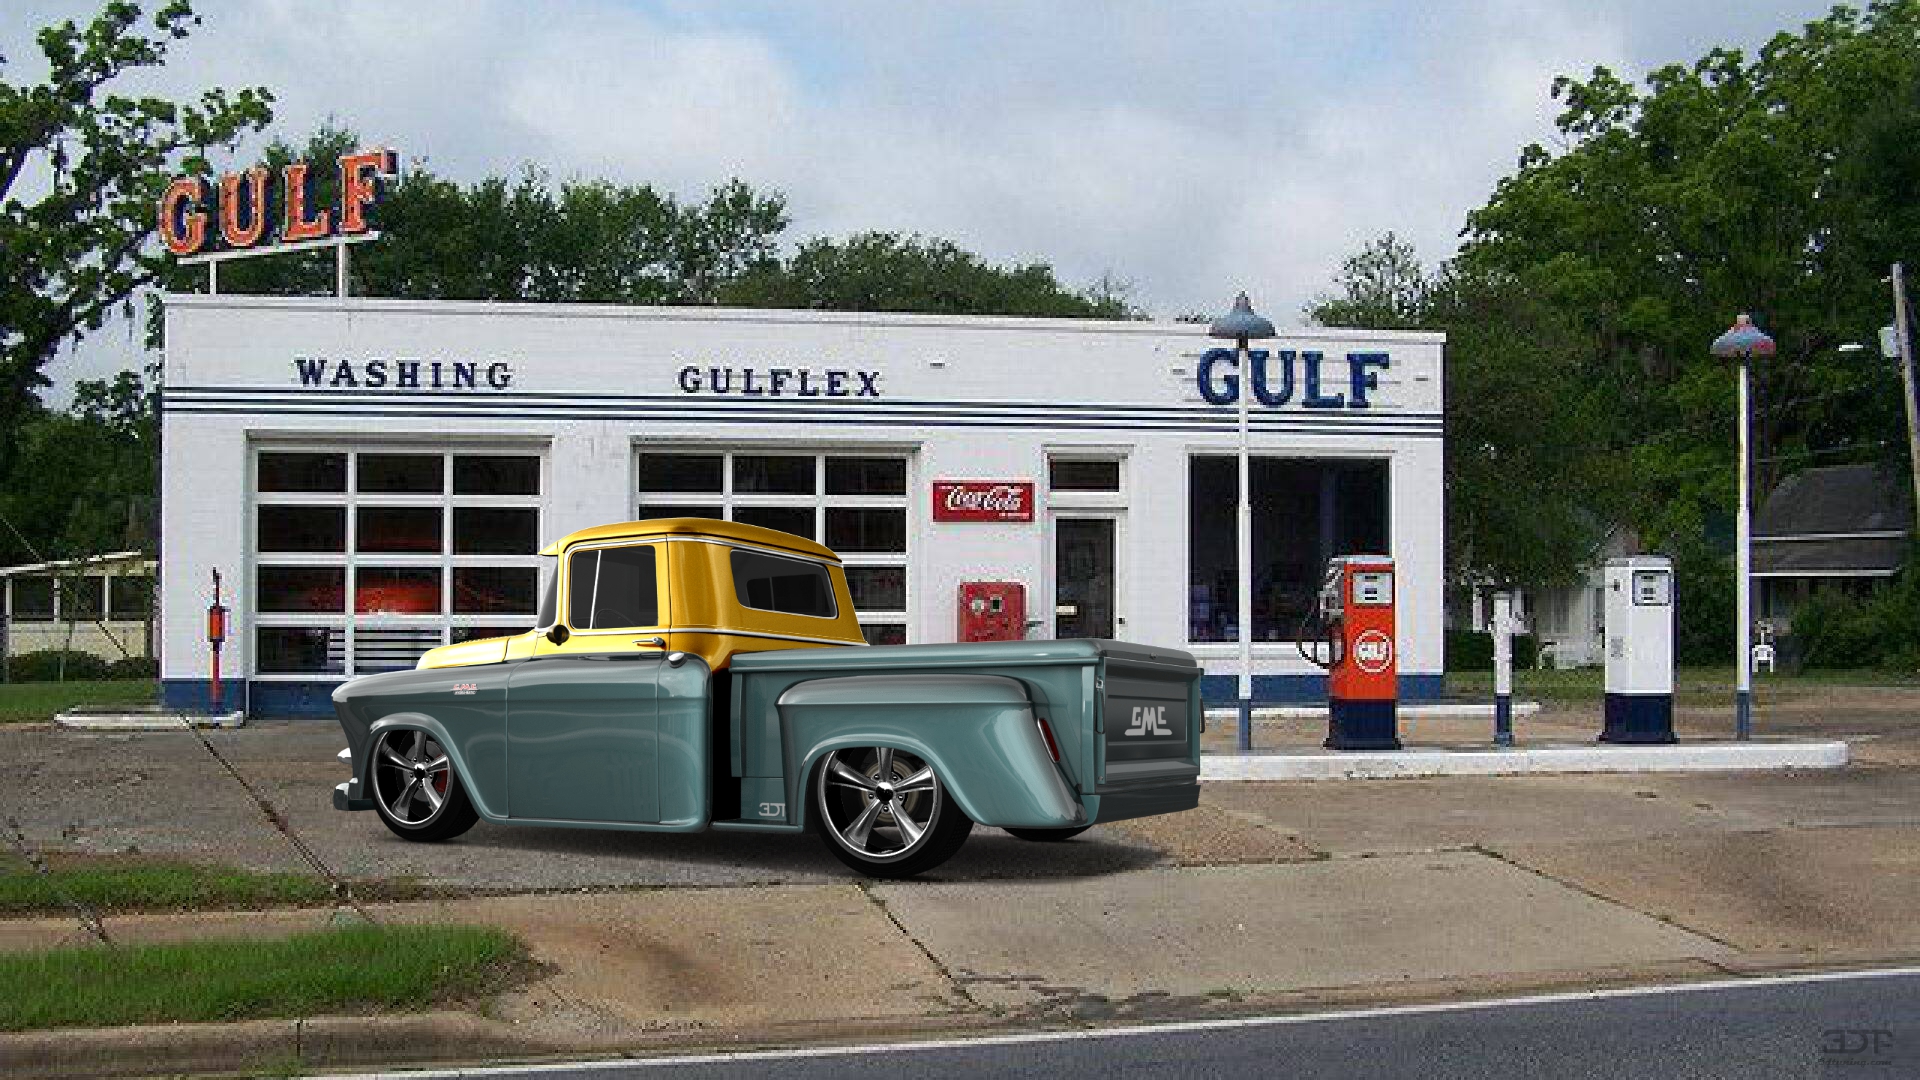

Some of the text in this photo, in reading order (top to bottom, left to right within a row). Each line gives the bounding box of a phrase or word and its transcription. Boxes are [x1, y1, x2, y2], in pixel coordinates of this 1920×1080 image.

[159, 150, 396, 255] GULF
[295, 358, 512, 390] WASHING
[678, 365, 880, 397] GULFLEX
[1197, 348, 1389, 408] GULF
[1124, 706, 1172, 736] GMC
